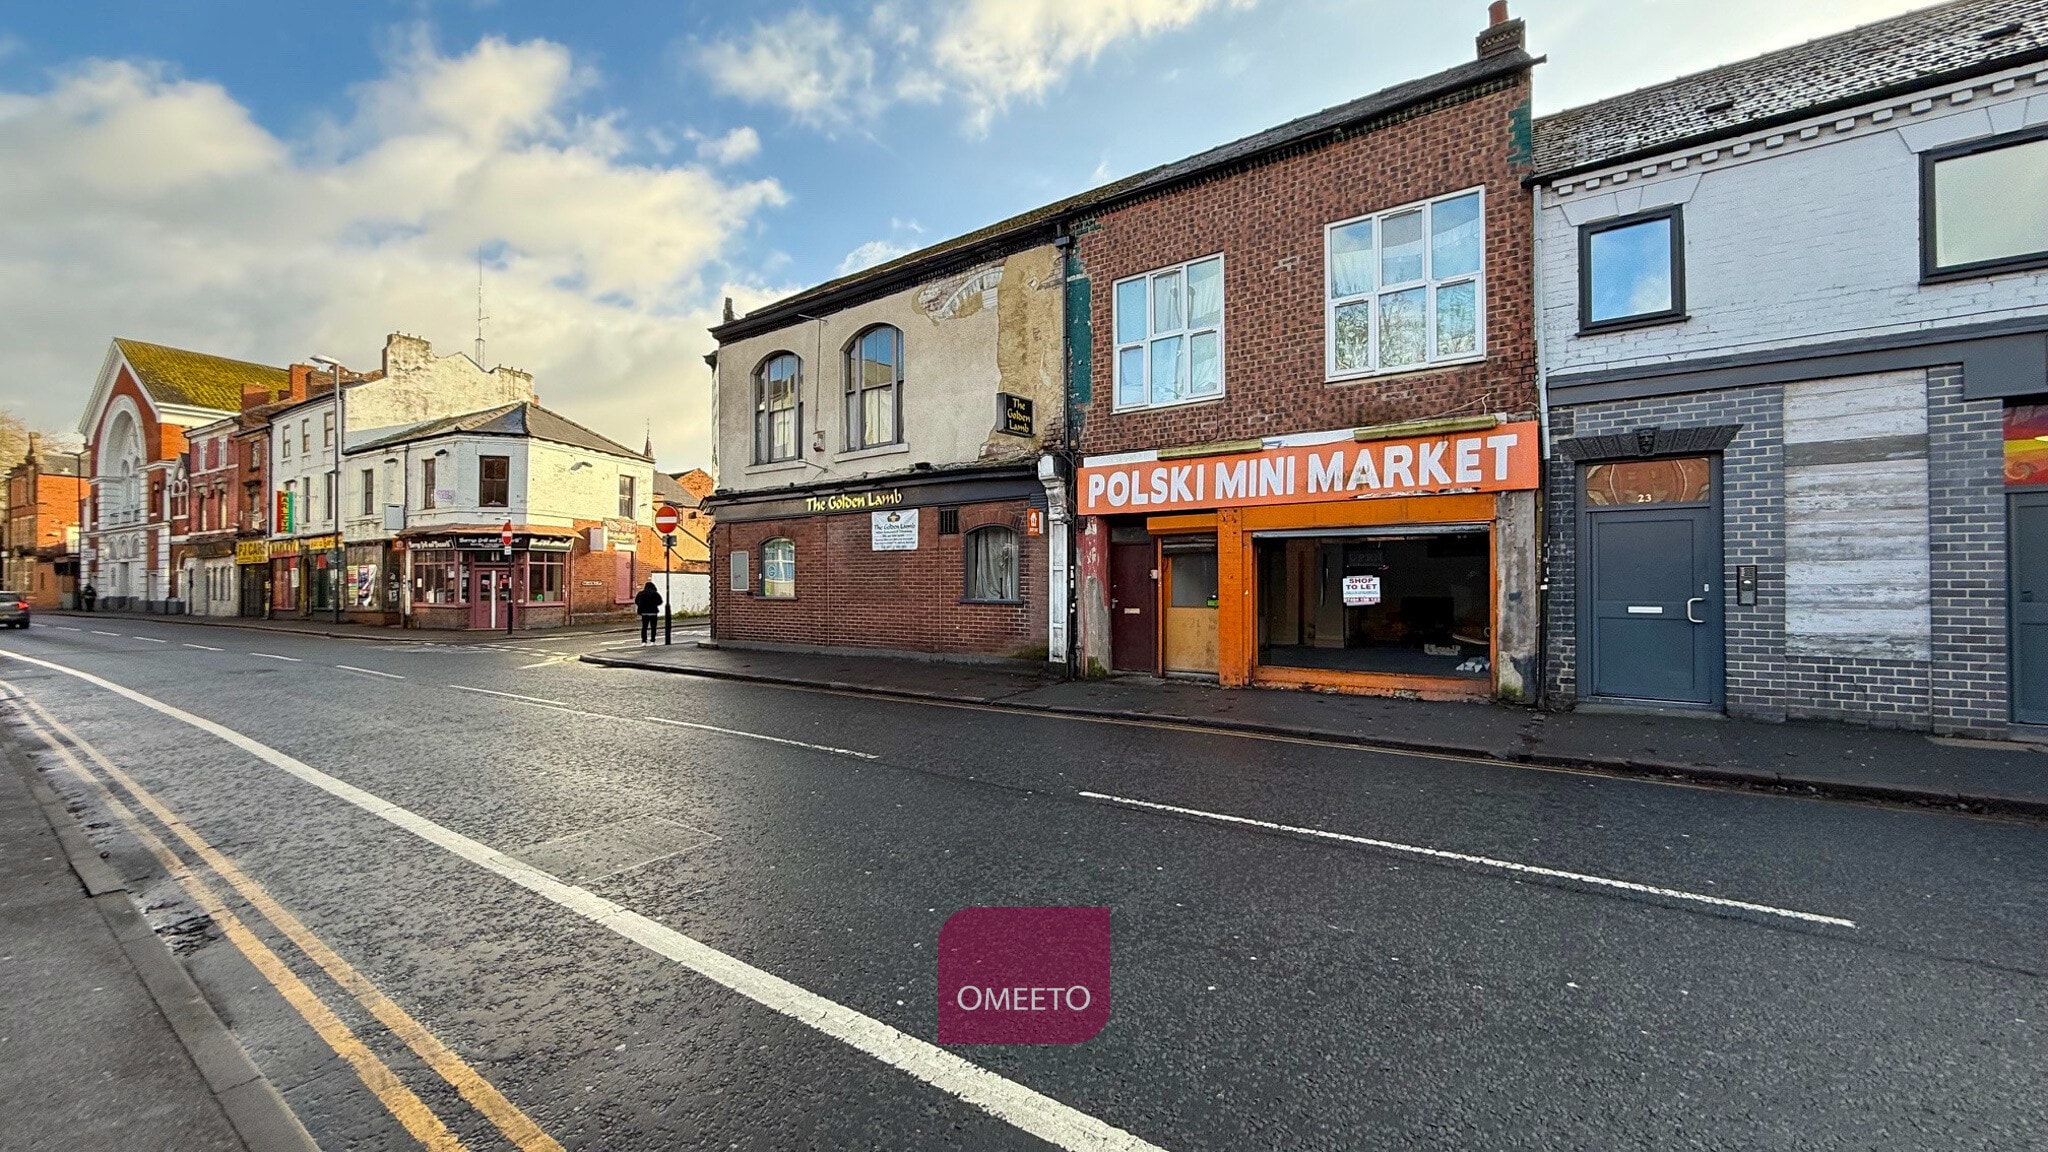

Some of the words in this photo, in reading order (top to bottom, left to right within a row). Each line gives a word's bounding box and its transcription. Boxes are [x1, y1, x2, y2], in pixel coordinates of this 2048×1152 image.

[1012, 397, 1025, 410] The
[1007, 408, 1031, 423] Golden
[1009, 419, 1029, 433] Lamb
[1087, 464, 1205, 508] POLSKI
[1215, 455, 1295, 499] MINI
[1307, 434, 1517, 494] MARKET
[805, 497, 826, 511] The
[828, 493, 865, 510] Golden
[867, 488, 902, 507] Lamb
[1637, 493, 1652, 503] 23
